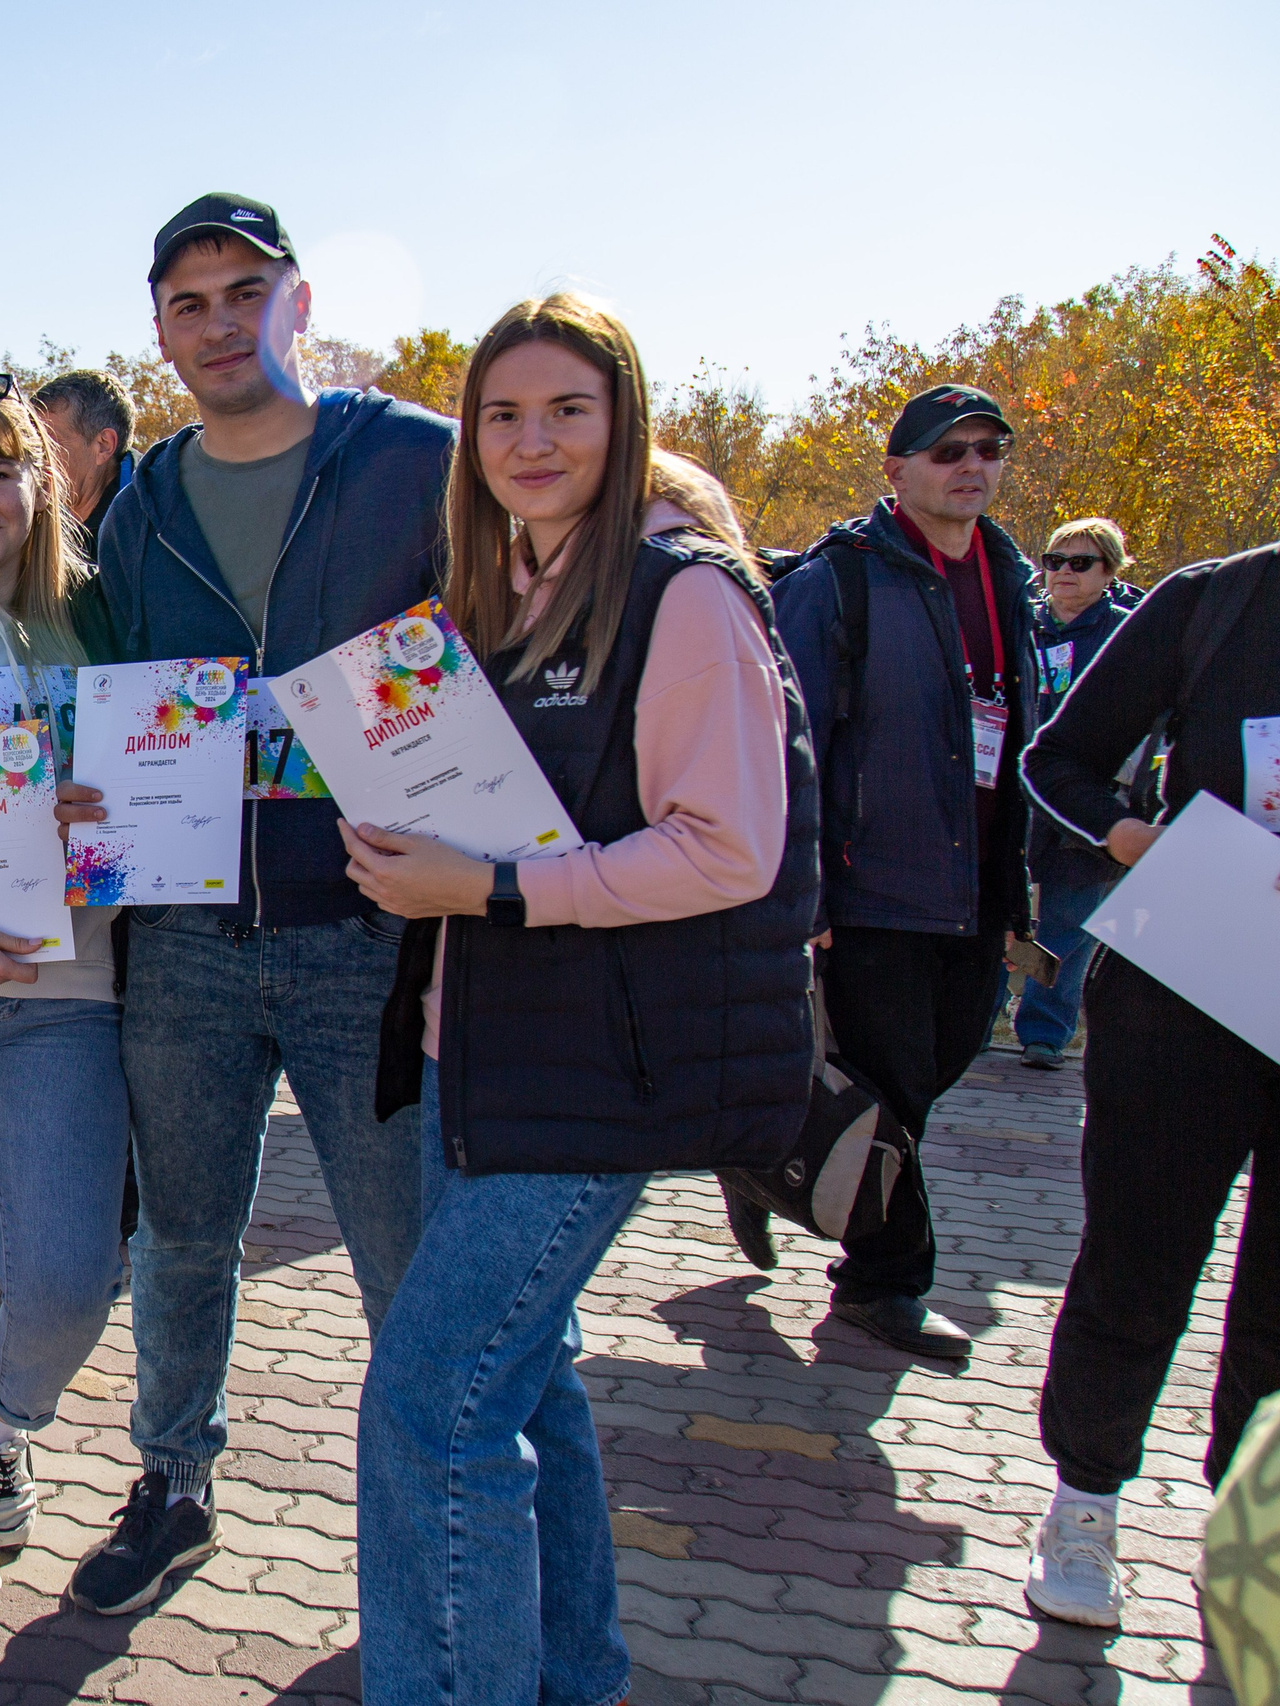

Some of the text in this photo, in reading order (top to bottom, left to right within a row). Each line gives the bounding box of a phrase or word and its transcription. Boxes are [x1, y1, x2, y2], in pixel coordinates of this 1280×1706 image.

[533, 693, 588, 708] adidas
[364, 702, 435, 750] ДИПЛОМ
[125, 733, 190, 755] ДИПЛОМ
[391, 734, 432, 757] НАГРАЖДАЕТСЯ
[138, 759, 176, 767] НАГРАЖДАЕТСЯ
